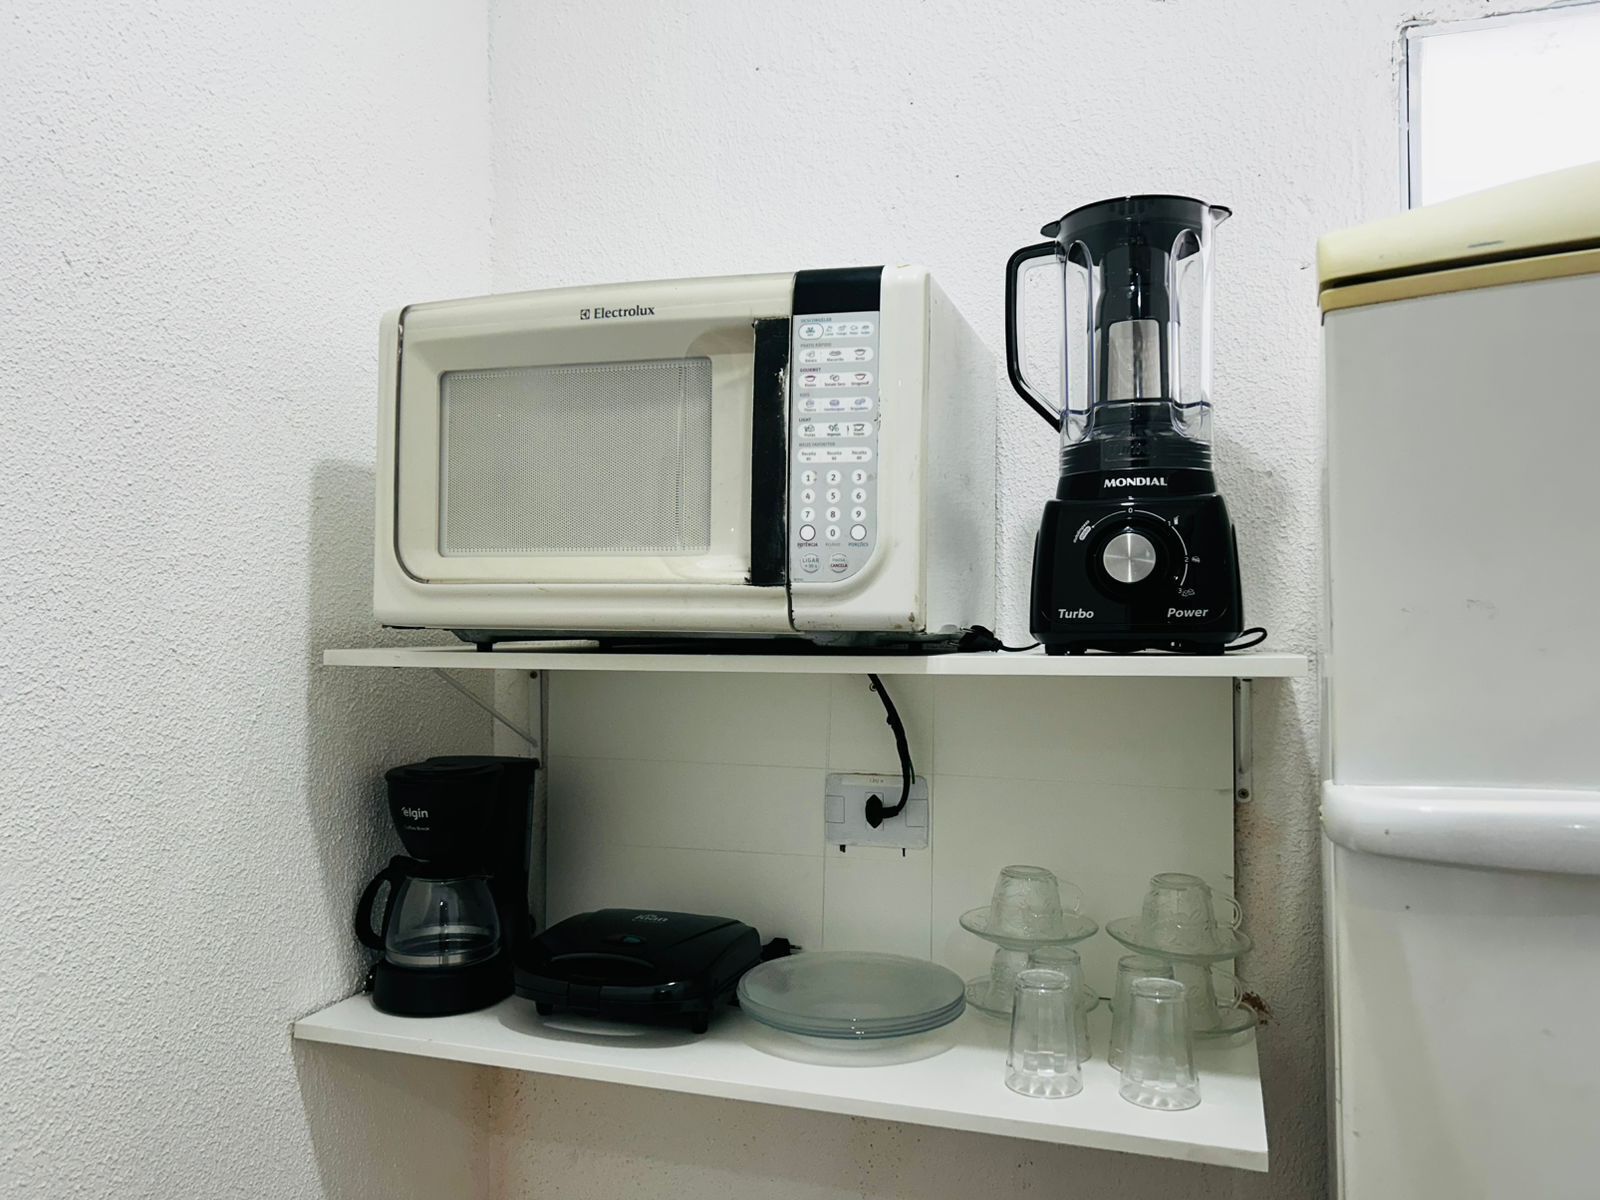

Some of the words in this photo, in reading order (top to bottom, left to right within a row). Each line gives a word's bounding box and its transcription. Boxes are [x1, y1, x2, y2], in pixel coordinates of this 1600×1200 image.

[594, 304, 655, 319] Electrolux
[1103, 477, 1168, 488] MONDIAL
[1058, 608, 1095, 619] Turbo
[1167, 607, 1209, 618] Power
